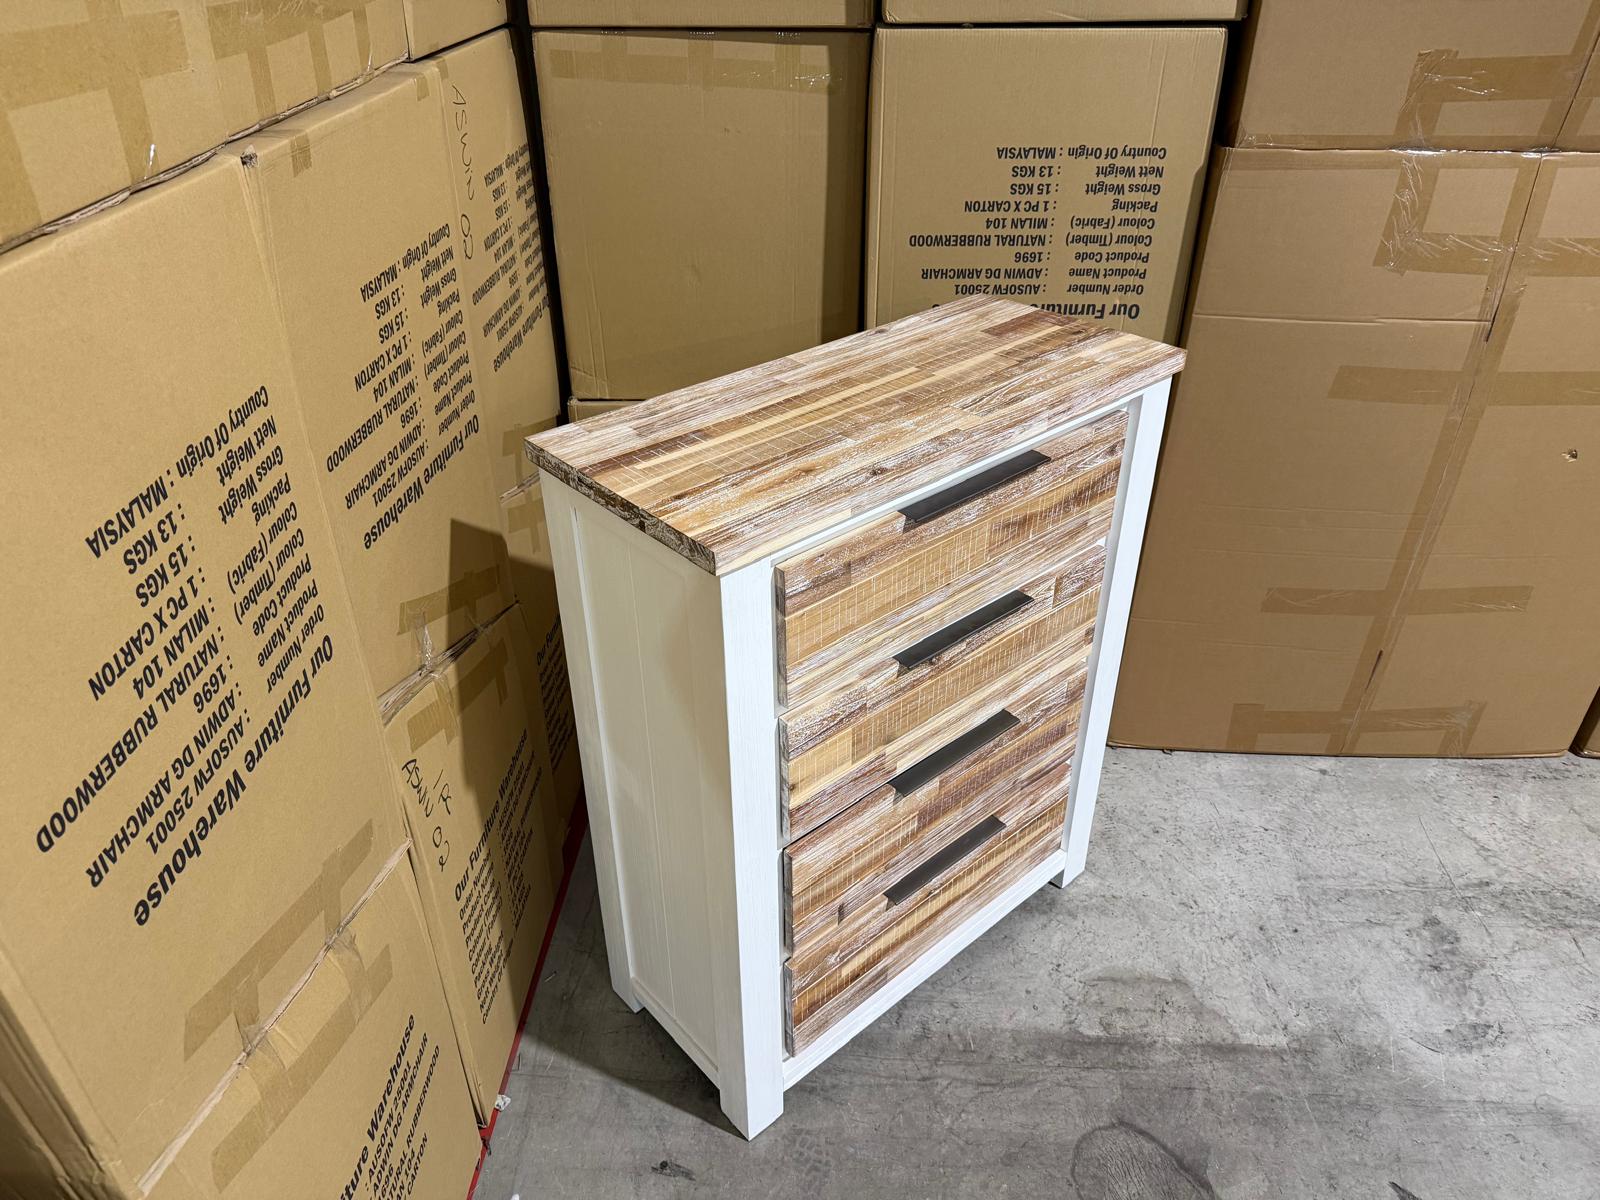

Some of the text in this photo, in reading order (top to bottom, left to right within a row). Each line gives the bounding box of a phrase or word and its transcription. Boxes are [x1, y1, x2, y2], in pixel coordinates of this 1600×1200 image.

[996, 144, 1166, 159] Country Of Origin MALAYSIA
[1009, 180, 1160, 195] Gross Weight 15 KGS
[1011, 163, 1163, 178] Nett Weight 13 KGS
[910, 231, 1152, 247] Colour (Timber) NATURAL RUBBERWOOD
[964, 198, 1158, 213] Packing 1 PC X CARTON
[985, 214, 1154, 229] Colour (Fabric) MILAN 104
[1013, 251, 1149, 263] Product Code 1696
[359, 222, 450, 302] Country Of Origin MALAYSIA
[374, 245, 453, 319] Nett Weight 13 KGS
[378, 267, 456, 344] Gross Weight 15 KGS
[921, 267, 1146, 280] Product Name ADWIN DG ARMCHAIR
[954, 283, 1143, 295] Order Number AUSOFW 25001
[1108, 303, 1140, 319] Our
[354, 287, 459, 391] Packing 1 PC X CARTON
[372, 309, 462, 402] Colour (Fabric) MILAN 104
[400, 348, 469, 428] Product Code 1696
[326, 330, 465, 471] Colour (Timber) NATURAL RUBBERWOOD
[344, 369, 472, 509] Product Name ADWIN DG ARMCHAIR
[372, 389, 474, 507] Order Number AUSOFW 25001
[84, 385, 268, 558] Country Of Origin MALAYSIA
[123, 414, 276, 574] Nett Weight 13 KGS
[363, 413, 478, 549] Our Furniture Warehouse
[135, 445, 283, 607] Gross Weight 15 KGS
[88, 472, 291, 701] Packing 1 PC X CARTON
[132, 501, 297, 699] Colour (Fabric) MILAN 104
[193, 552, 311, 713] Product Code 1696
[36, 527, 304, 852] Colour (Timber) NATURAL RUBBERWOOD
[85, 578, 318, 887] Product Name ADWIN DG ARMCHAIR
[145, 604, 324, 854] Order Number AUSOFW 25001
[133, 634, 332, 925] Our Furniture Warehouse
[454, 865, 468, 902] Our
[469, 799, 499, 871] Furniture
[366, 1014, 415, 1142] Warehouse
[368, 1060, 412, 1184] AUSOFW 25001
[373, 1032, 428, 1197] ADWIN DG ARMCHAIR
[406, 1045, 440, 1150] RUBBERWOOD
[404, 1147, 416, 1181] 104
[407, 1132, 428, 1196] CARTON
